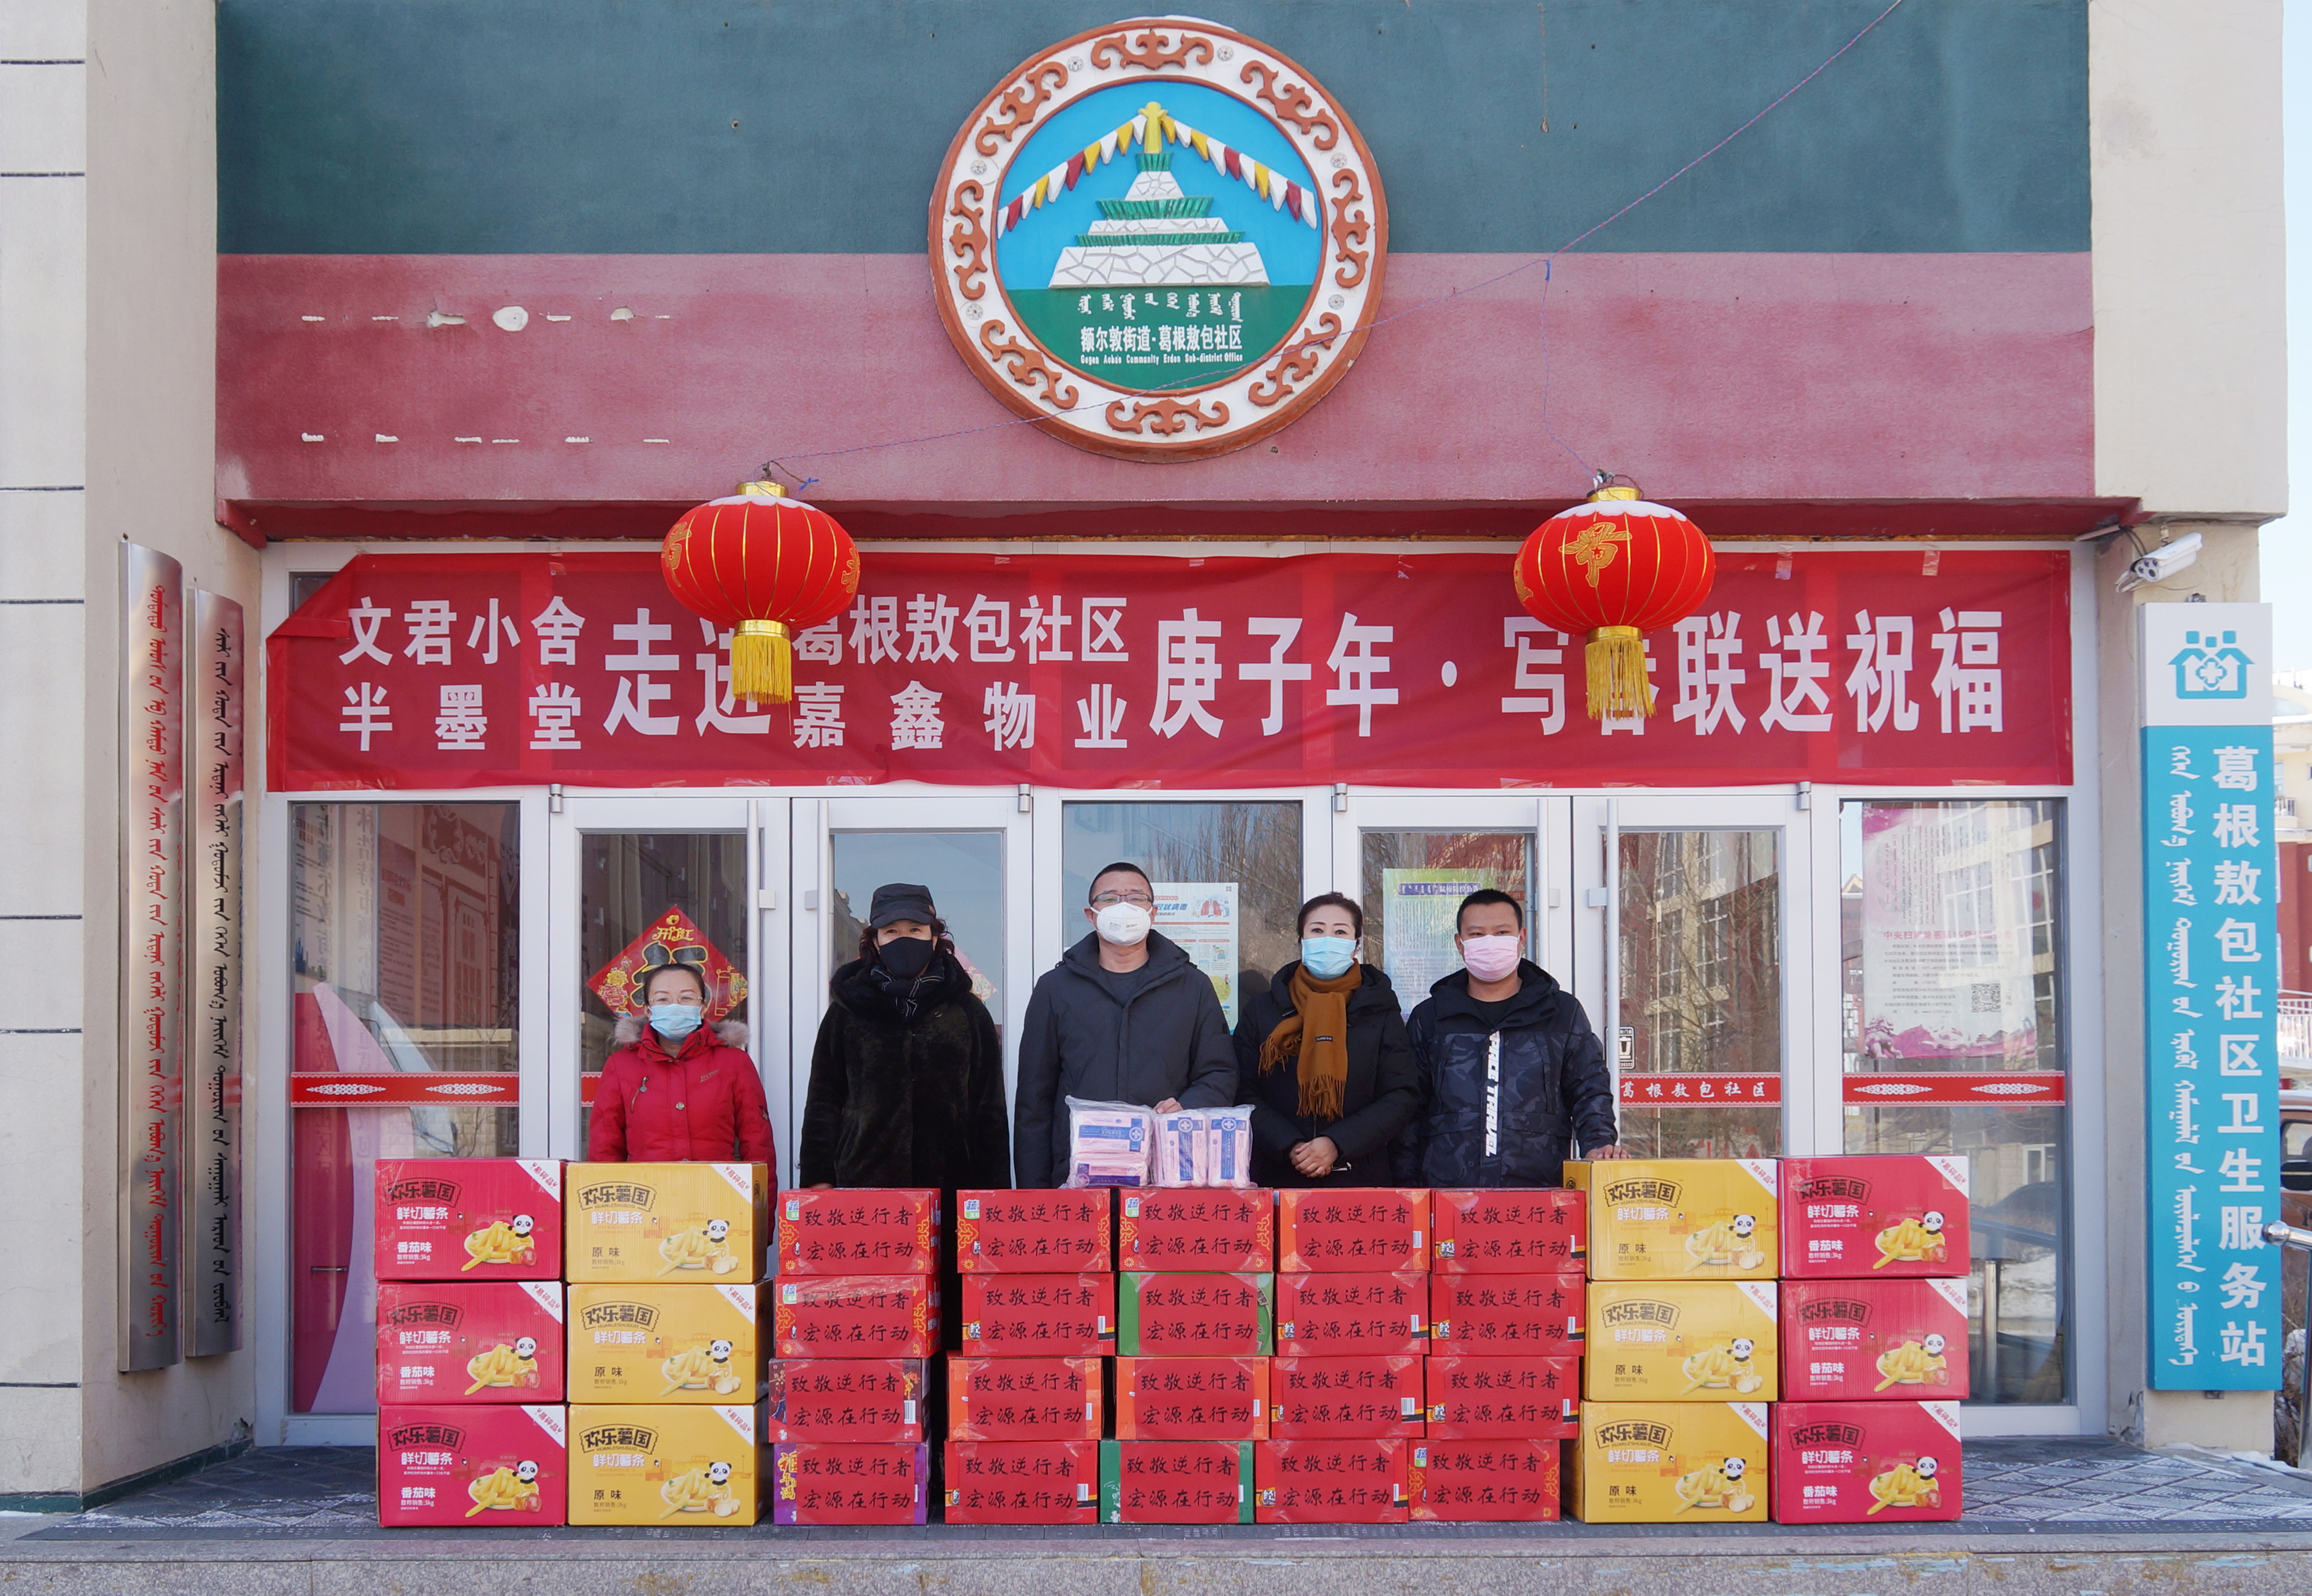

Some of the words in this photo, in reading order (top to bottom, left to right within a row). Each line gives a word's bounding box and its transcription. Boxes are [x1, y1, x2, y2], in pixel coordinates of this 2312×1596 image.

[1126, 354, 1159, 365] Community
[1224, 352, 1243, 362] Office
[339, 595, 586, 666] 文君小舍
[792, 593, 1129, 665] 葛根敖包社区
[339, 681, 582, 752] 半墨堂
[793, 680, 1128, 751] 嘉鑫物业
[2212, 746, 2267, 1367] 葛根敖包社区卫生服务站
[1621, 1081, 1765, 1098] 葛根敖包社区
[1486, 1084, 1499, 1157] TRAVEL
[397, 1207, 448, 1220] 鲜切薯条
[591, 1211, 643, 1225] 鲜切薯条
[805, 1206, 913, 1226] 致敬逆行者
[986, 1203, 1094, 1223] 致敬逆行者
[1145, 1203, 1253, 1223] 致敬逆行者
[1303, 1204, 1410, 1224] 致敬逆行者
[1461, 1205, 1568, 1225] 致敬逆行者
[1617, 1207, 1669, 1221] 鲜切薯条
[1807, 1205, 1858, 1218] 鲜切薯条
[397, 1242, 432, 1253] 番茄味
[592, 1247, 620, 1258] 原味
[806, 1241, 913, 1260] 宏源在行动
[987, 1237, 1094, 1257] 宏源在行动
[1145, 1235, 1253, 1255] 宏源在行动
[1304, 1238, 1410, 1258] 宏源在行动
[1461, 1239, 1567, 1258] 宏源在行动
[1619, 1243, 1646, 1254] 原味
[1809, 1240, 1843, 1252] 番茄味
[986, 1287, 1094, 1307] 致敬逆行者
[1146, 1287, 1254, 1308] 致敬逆行者
[1300, 1285, 1407, 1305] 致敬逆行者
[1457, 1289, 1565, 1308] 致敬逆行者
[400, 1331, 451, 1344] 鲜切薯条
[594, 1331, 646, 1344] 鲜切薯条
[803, 1323, 909, 1343] 宏源在行动
[987, 1320, 1094, 1340] 宏源在行动
[1146, 1321, 1254, 1340] 宏源在行动
[1300, 1320, 1407, 1340] 宏源在行动
[1456, 1321, 1564, 1340] 宏源在行动
[1615, 1329, 1667, 1342] 鲜切薯条
[1809, 1327, 1860, 1340] 鲜切薯条
[400, 1366, 435, 1378] 番茄味
[595, 1367, 622, 1377] 原味
[1615, 1365, 1643, 1375] 原味
[1810, 1363, 1845, 1374] 番茄味
[791, 1372, 899, 1392] 致敬逆行者
[974, 1372, 1082, 1391] 致敬逆行者
[1142, 1371, 1250, 1391] 致敬逆行者
[1290, 1369, 1397, 1389] 致敬逆行者
[1452, 1369, 1559, 1389] 致敬逆行者
[793, 1407, 900, 1426] 宏源在行动
[976, 1406, 1082, 1425] 宏源在行动
[1142, 1405, 1250, 1425] 宏源在行动
[1290, 1404, 1398, 1423] 宏源在行动
[1452, 1404, 1559, 1423] 宏源在行动
[401, 1452, 452, 1465] 鲜切薯条
[593, 1454, 645, 1467] 鲜切薯条
[1127, 1456, 1235, 1475] 致敬逆行者
[1281, 1453, 1389, 1473] 致敬逆行者
[1433, 1452, 1541, 1472] 致敬逆行者
[1608, 1449, 1660, 1463] 鲜切薯条
[1801, 1450, 1853, 1464] 鲜切薯条
[803, 1457, 911, 1477] 致敬逆行者
[966, 1457, 1074, 1477] 致敬逆行者
[401, 1488, 436, 1499] 番茄味
[594, 1490, 622, 1500] 原味
[803, 1490, 910, 1510] 宏源在行动
[966, 1490, 1073, 1509] 宏源在行动
[1128, 1488, 1235, 1508] 宏源在行动
[1283, 1487, 1389, 1507] 宏源在行动
[1433, 1485, 1541, 1504] 宏源在行动
[1609, 1486, 1637, 1496] 原味
[1803, 1486, 1837, 1497] 番茄味
